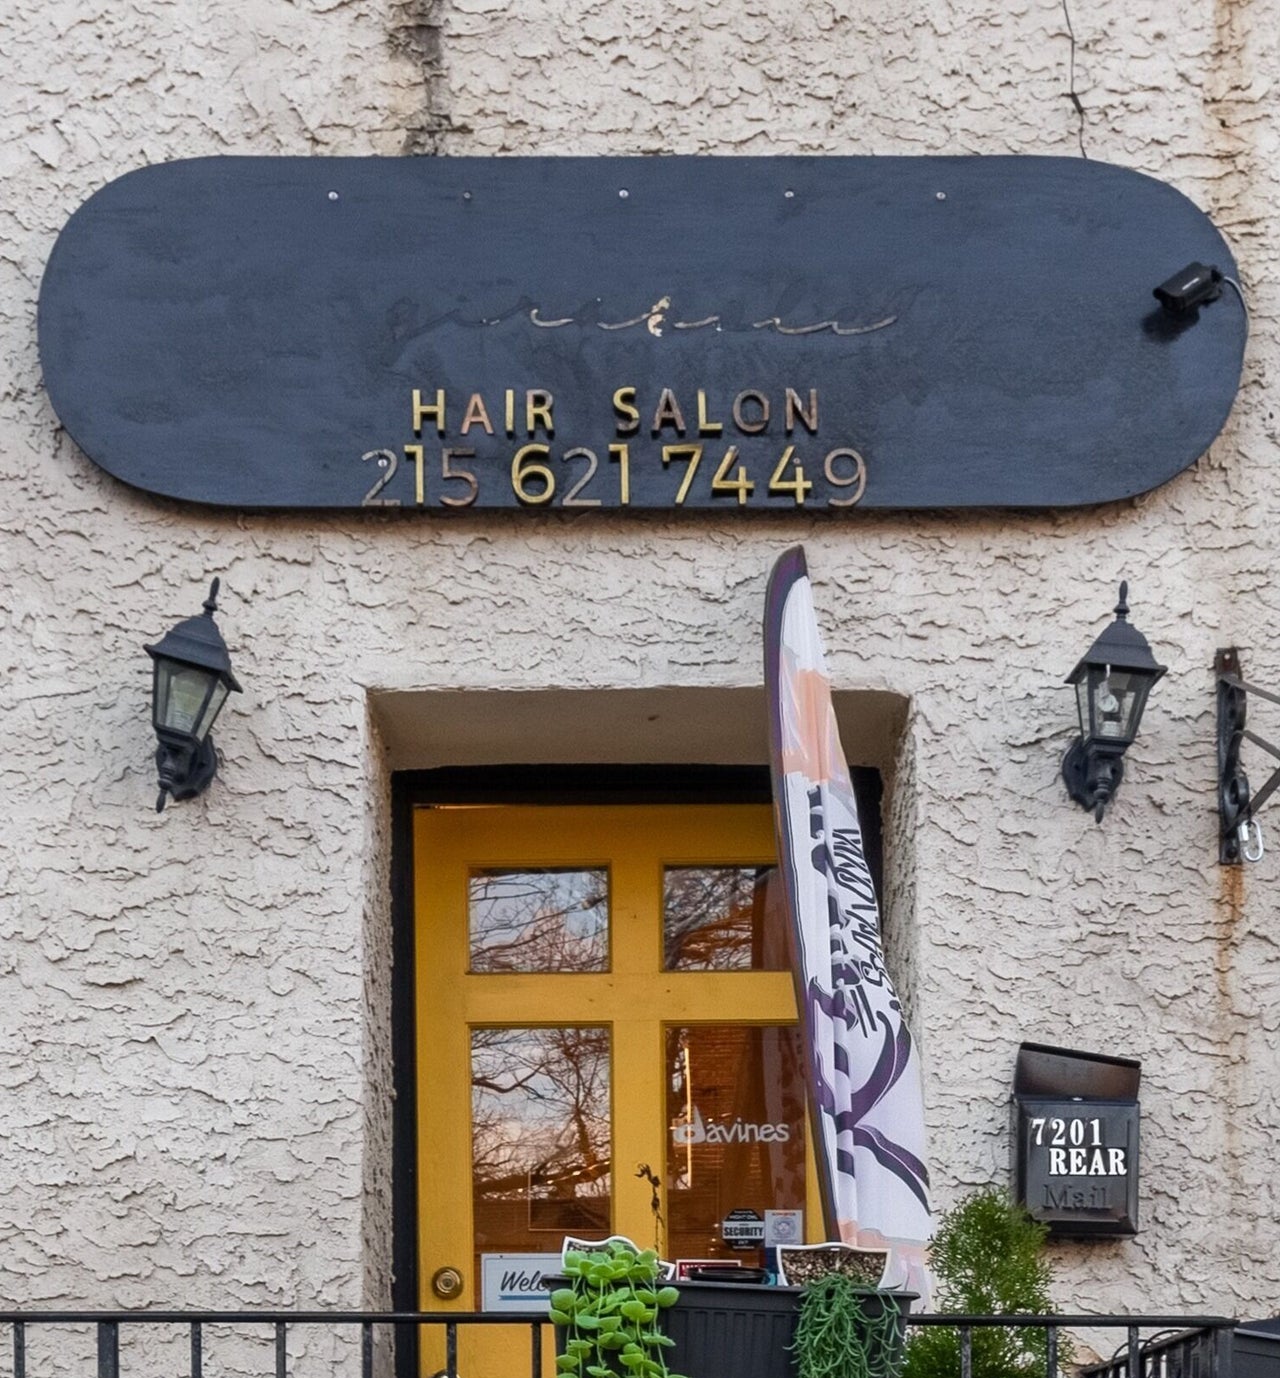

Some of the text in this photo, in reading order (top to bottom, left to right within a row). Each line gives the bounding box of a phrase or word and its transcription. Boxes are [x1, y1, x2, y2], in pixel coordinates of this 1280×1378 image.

[412, 387, 818, 435] HAIR SALON
[361, 444, 867, 507] 215 621 7449
[674, 1105, 790, 1144] davines
[1032, 1118, 1103, 1146] 7201
[1049, 1148, 1128, 1176] REAR
[1042, 1184, 1113, 1209] Mail
[724, 1226, 763, 1237] SECURITY
